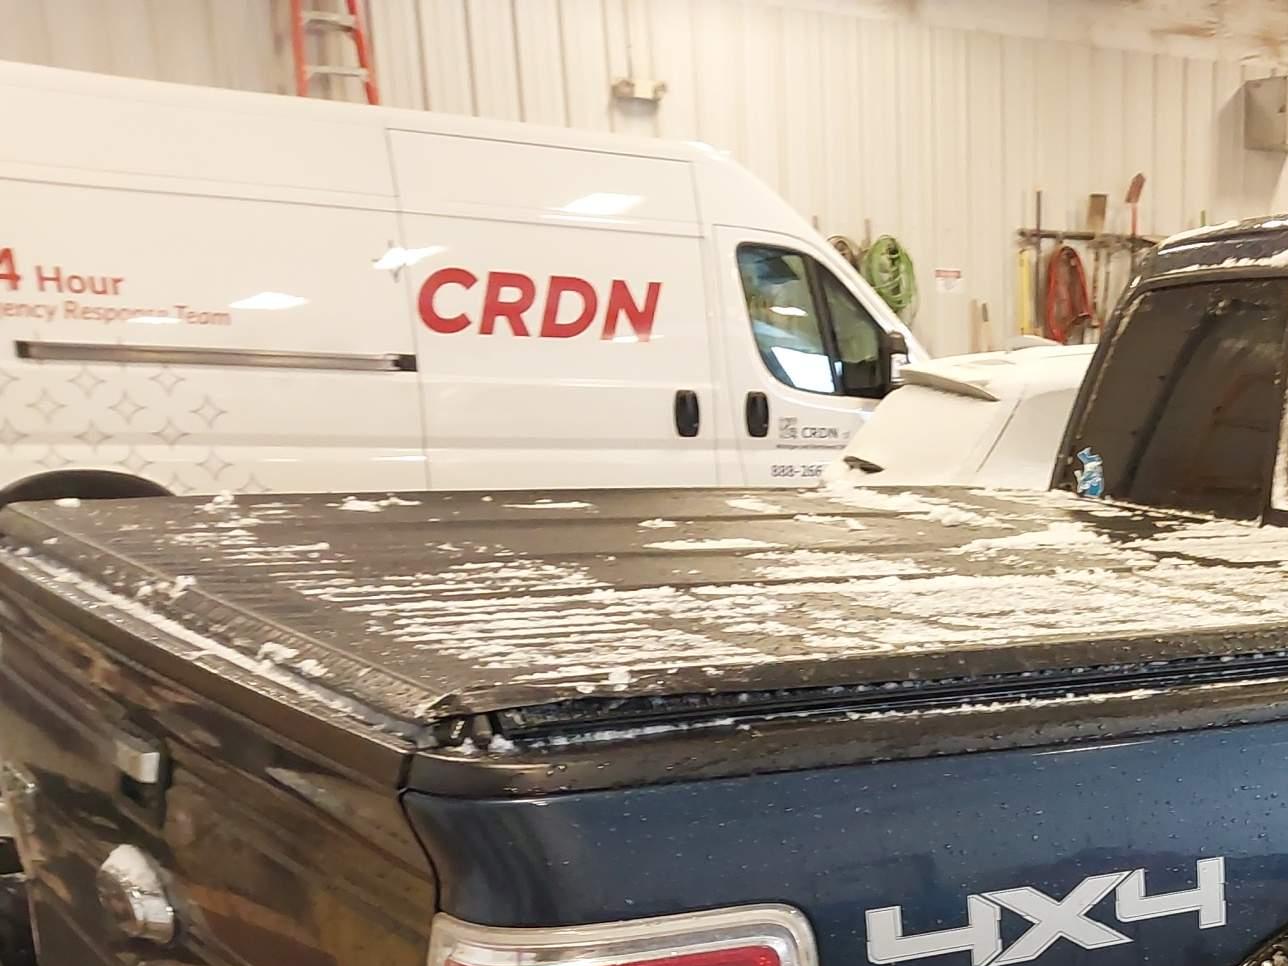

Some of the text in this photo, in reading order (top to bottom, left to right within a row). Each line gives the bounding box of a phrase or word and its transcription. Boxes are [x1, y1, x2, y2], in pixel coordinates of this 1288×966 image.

[35, 264, 124, 295] Hour
[0, 302, 57, 322] ency
[173, 305, 232, 325] Team
[417, 267, 665, 343] CRDN
[801, 427, 839, 439] CRDN
